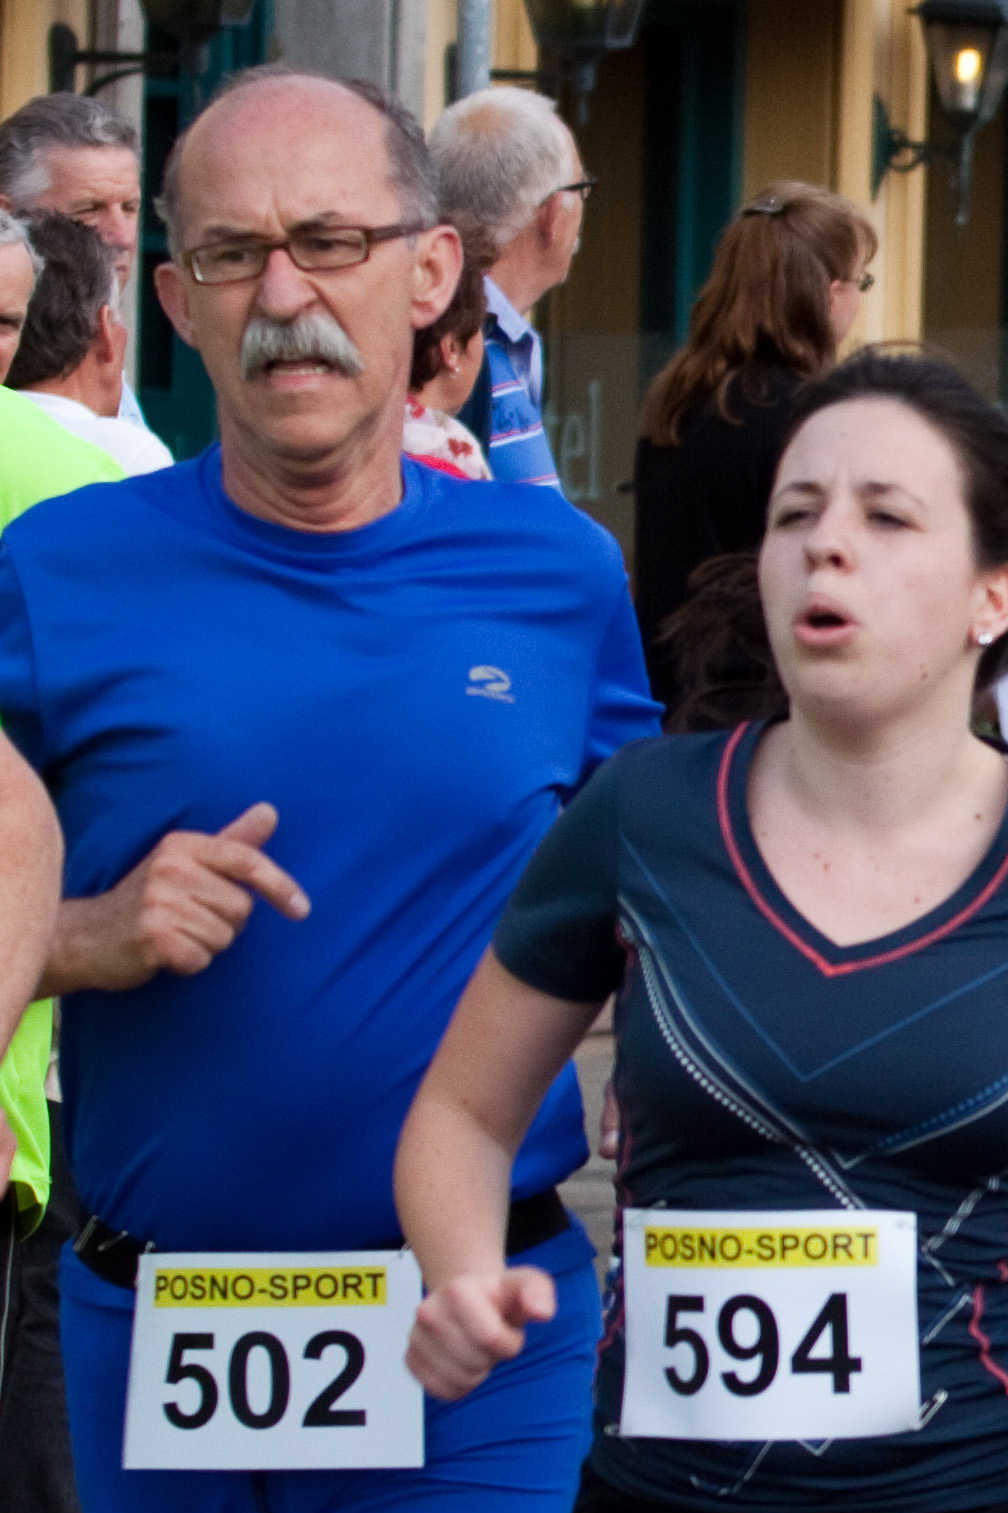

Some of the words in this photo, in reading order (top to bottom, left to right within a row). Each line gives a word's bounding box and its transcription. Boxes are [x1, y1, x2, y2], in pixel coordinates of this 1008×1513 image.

[644, 1232, 876, 1262] POSNO-SPORT
[154, 1272, 385, 1301] POSNO-SPORT
[663, 1291, 863, 1397] 594
[162, 1329, 367, 1430] 502
